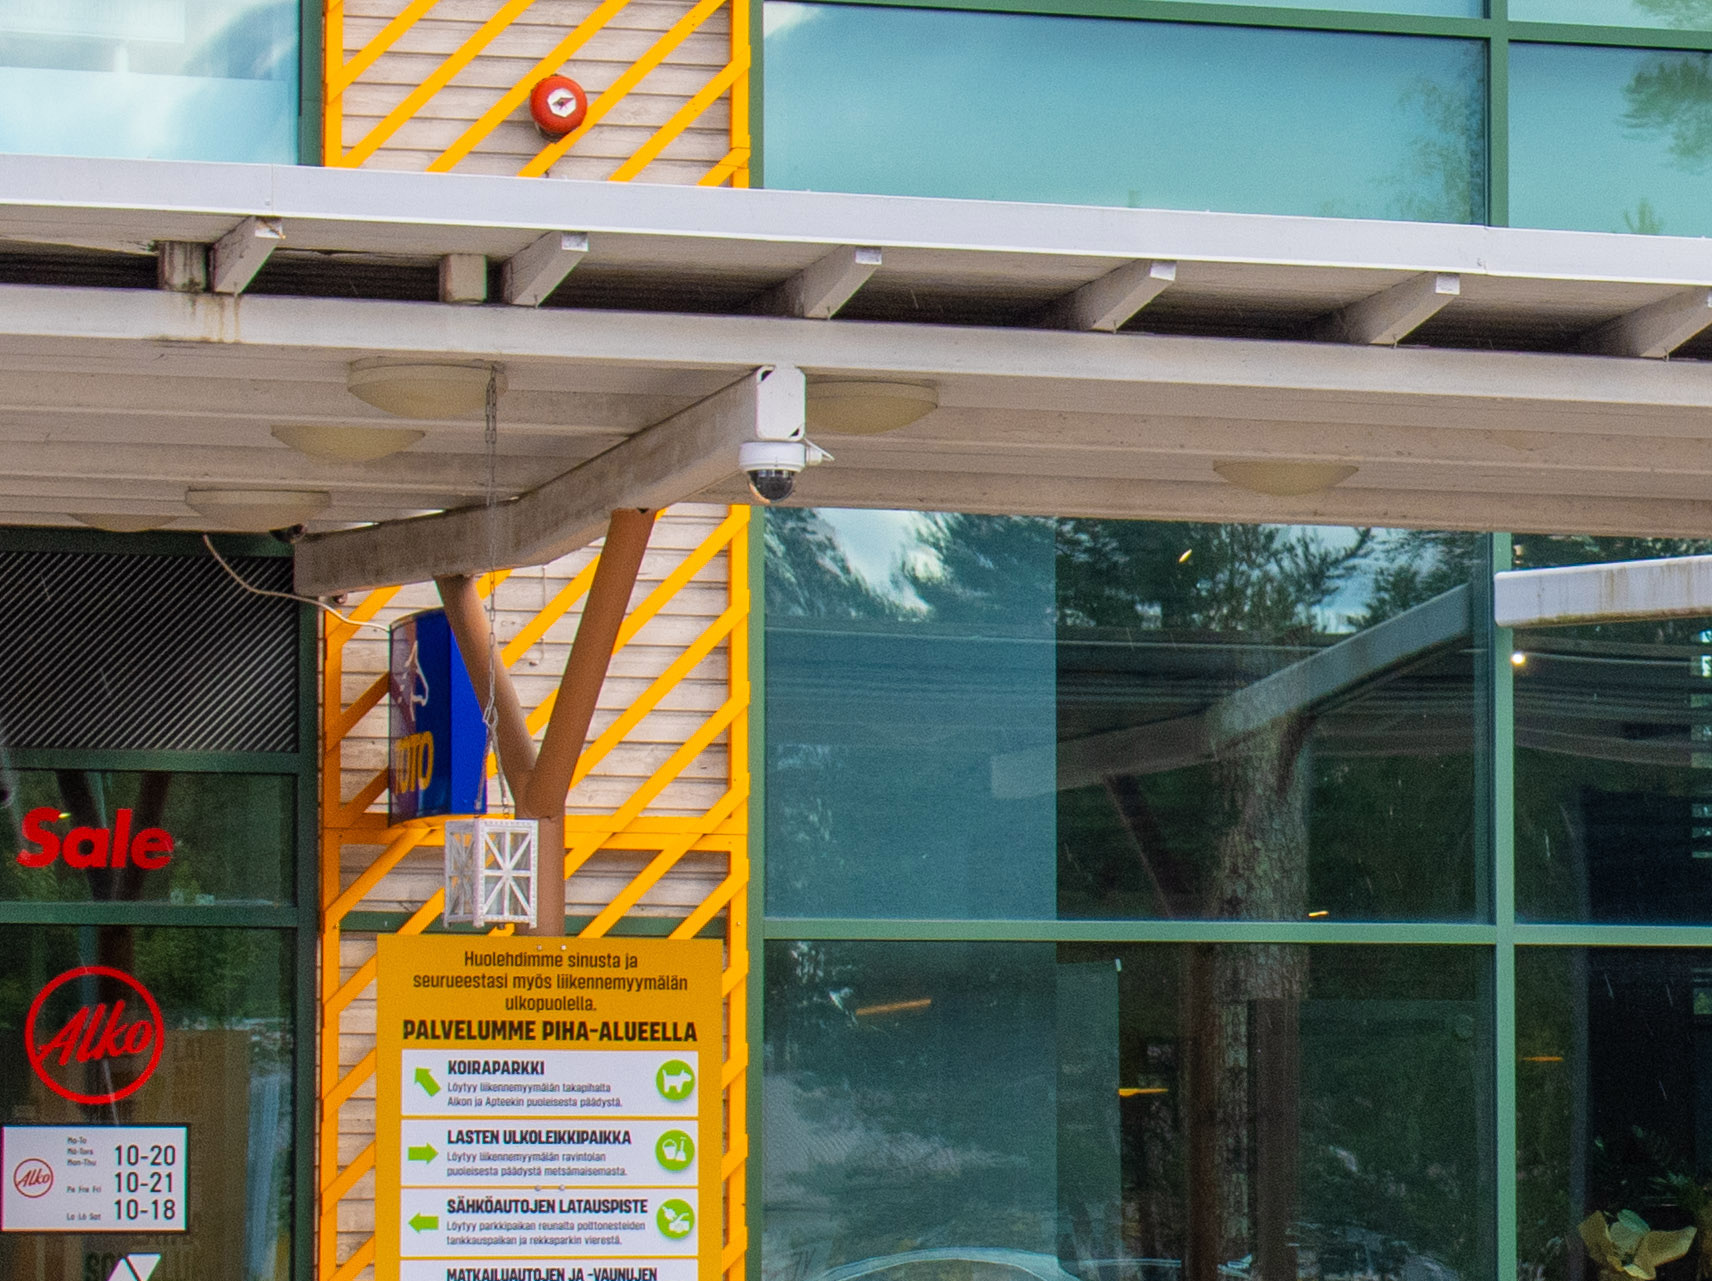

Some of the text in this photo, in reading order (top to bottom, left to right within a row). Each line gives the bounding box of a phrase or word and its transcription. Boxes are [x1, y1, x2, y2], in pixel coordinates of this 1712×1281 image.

[17, 806, 174, 870] Sale
[464, 951, 638, 970] Huolehdimme sinusta ja
[413, 973, 688, 992] seurueestasi myös liikennemyymälän
[505, 995, 597, 1012] ulkopuolella.
[36, 1001, 154, 1066] Alko
[402, 1020, 698, 1043] PALVELUMME PIHA-ALUEELLA
[448, 1060, 546, 1076] KOIRAPARKKI
[447, 1082, 478, 1094] Löytyy
[485, 1096, 525, 1108] Apteekin
[527, 1097, 578, 1108] puoleisesta
[447, 1129, 632, 1146] LASTEN ULKOLEIKKIPAIKKA
[114, 1144, 176, 1167] 10-20
[447, 1151, 477, 1163] Löytyy
[562, 1152, 606, 1162] ravintolan
[17, 1168, 51, 1188] Alko
[447, 1166, 499, 1177] puoleisesta
[501, 1166, 542, 1177] päädystä
[114, 1171, 173, 1194] 10-21
[114, 1198, 176, 1221] 10-18
[446, 1195, 649, 1214] SÄHKÖAUTOJEN LATAUSPISTE
[446, 1221, 477, 1232] Löytyy
[479, 1221, 536, 1232] parkkipaikan
[538, 1221, 575, 1231] reunalta
[519, 1235, 528, 1246] ja
[530, 1235, 582, 1246] rekkaparkin
[568, 1268, 584, 1281] JA
[587, 1268, 658, 1281] -VAUNUJEN
